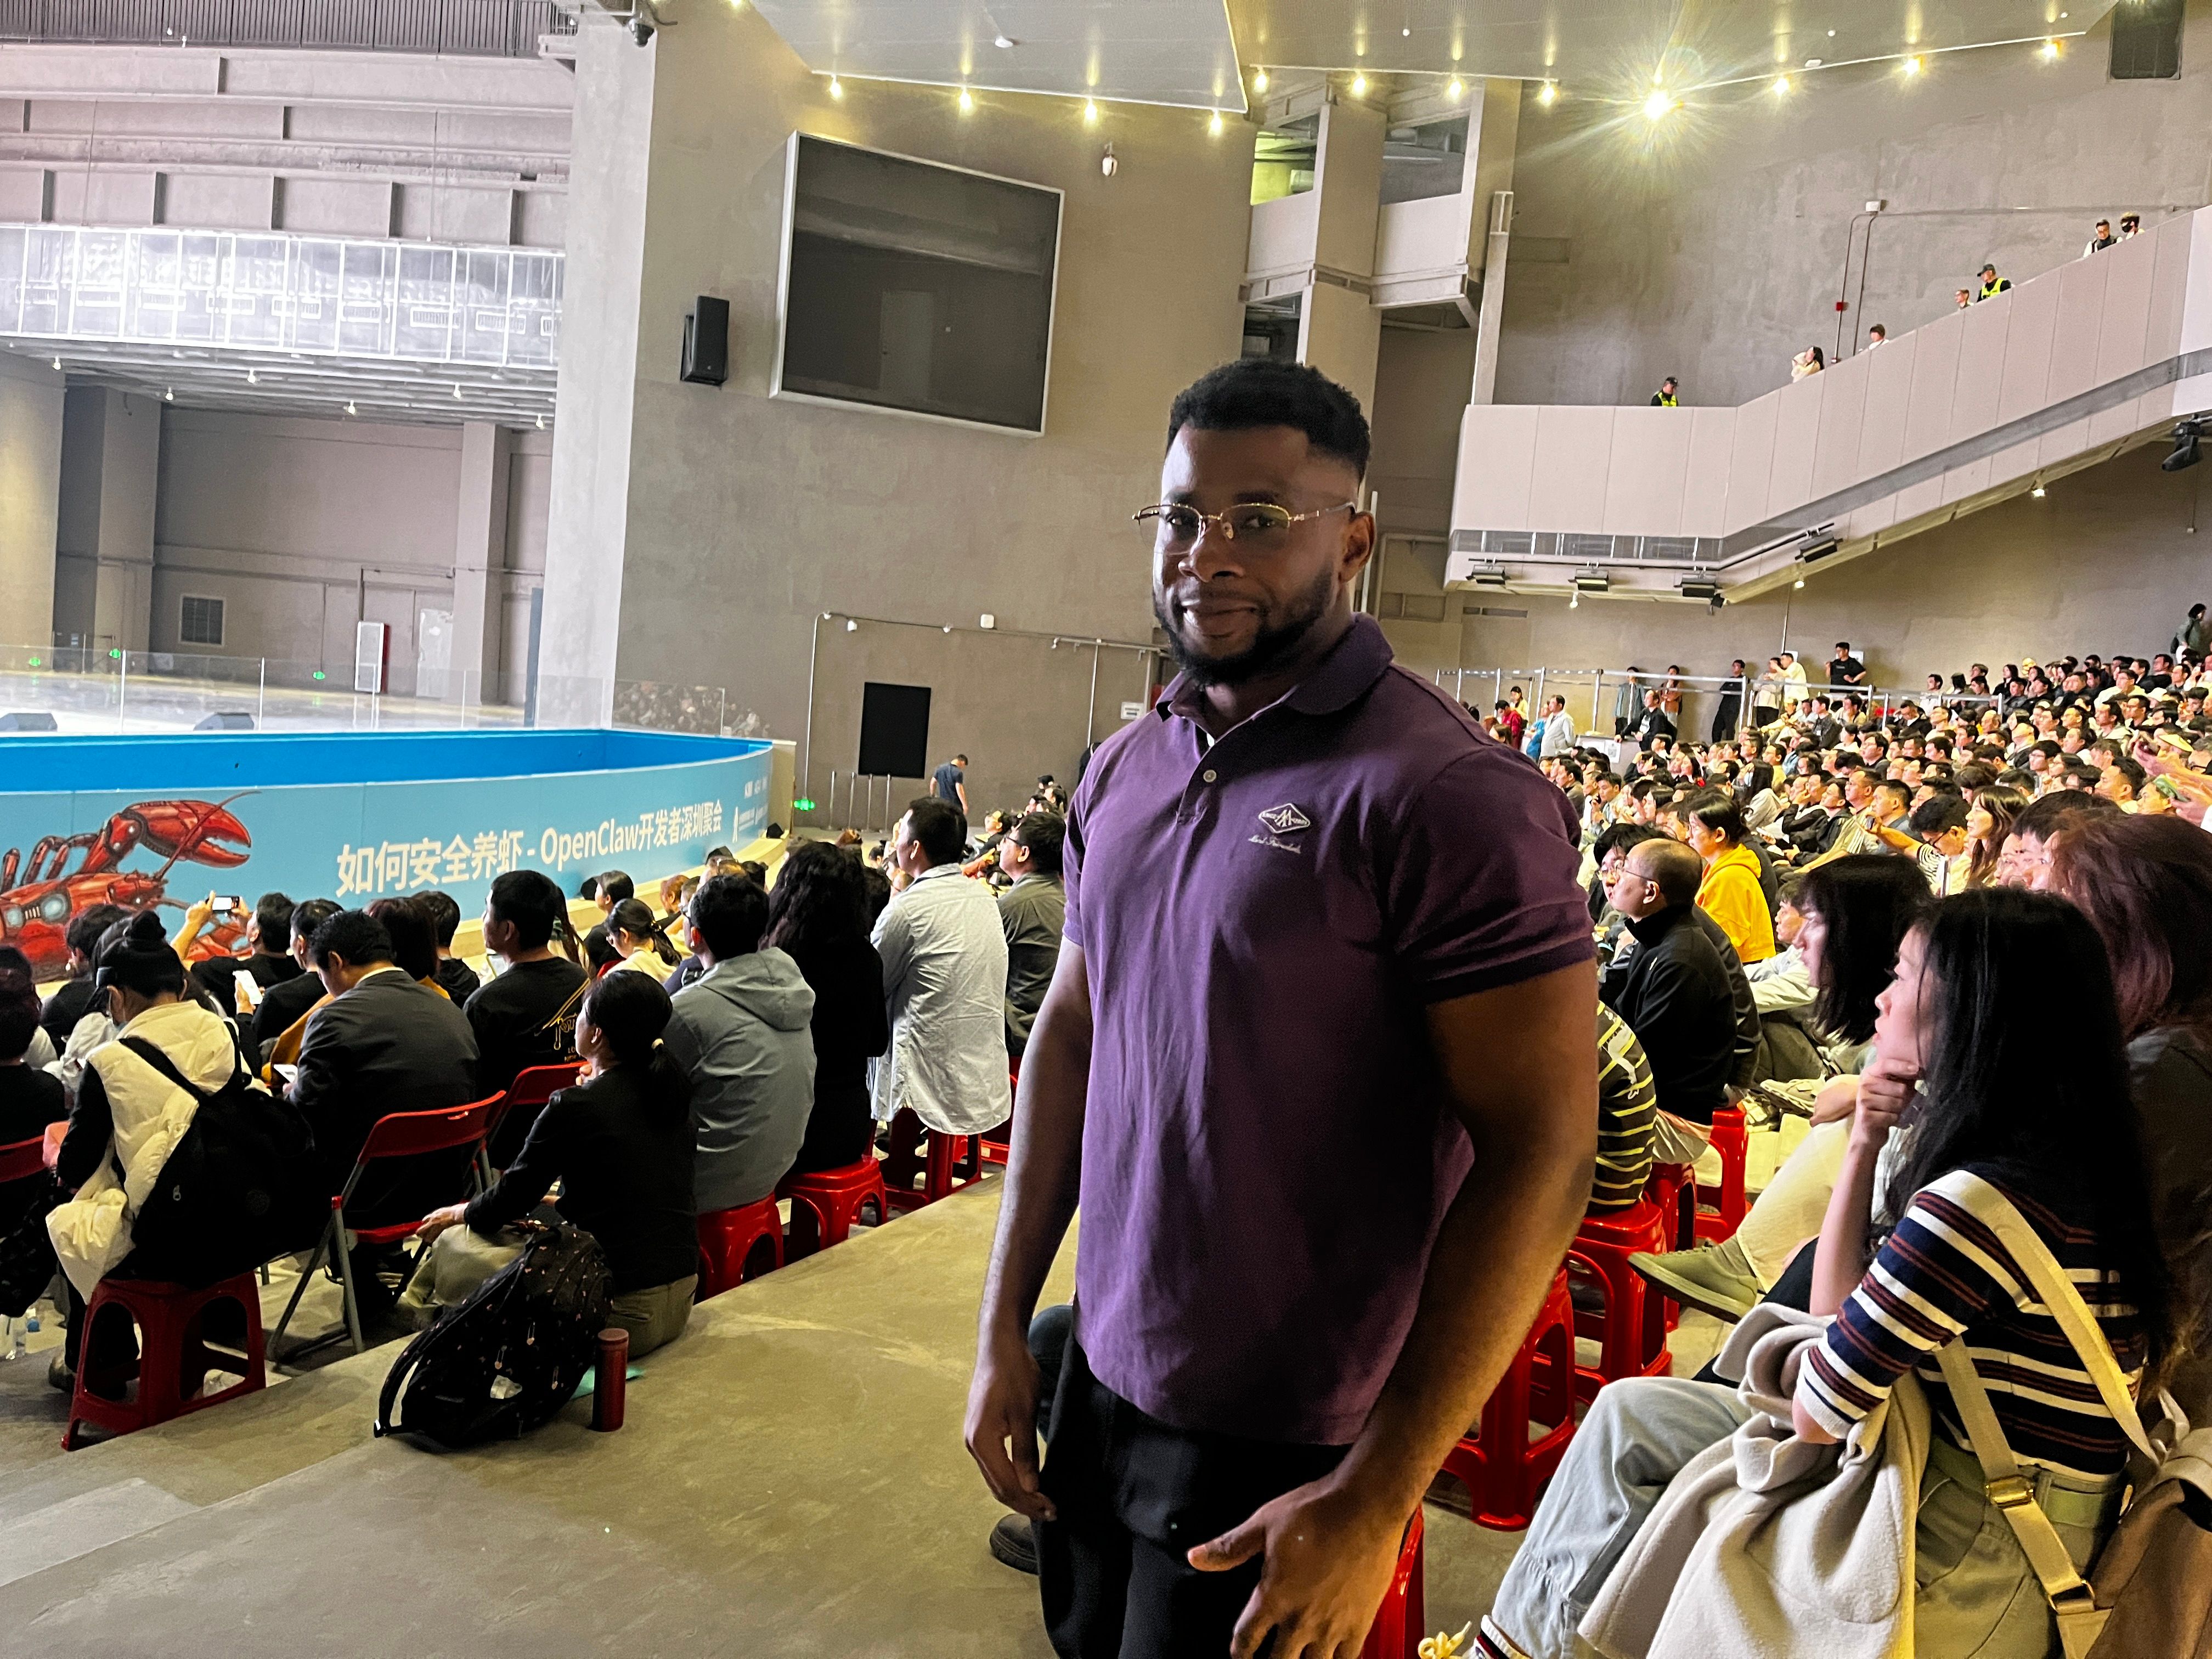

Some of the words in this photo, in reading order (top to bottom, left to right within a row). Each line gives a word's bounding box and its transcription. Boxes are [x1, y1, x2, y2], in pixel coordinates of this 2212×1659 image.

[336, 830, 523, 898] 如何安全养虾
